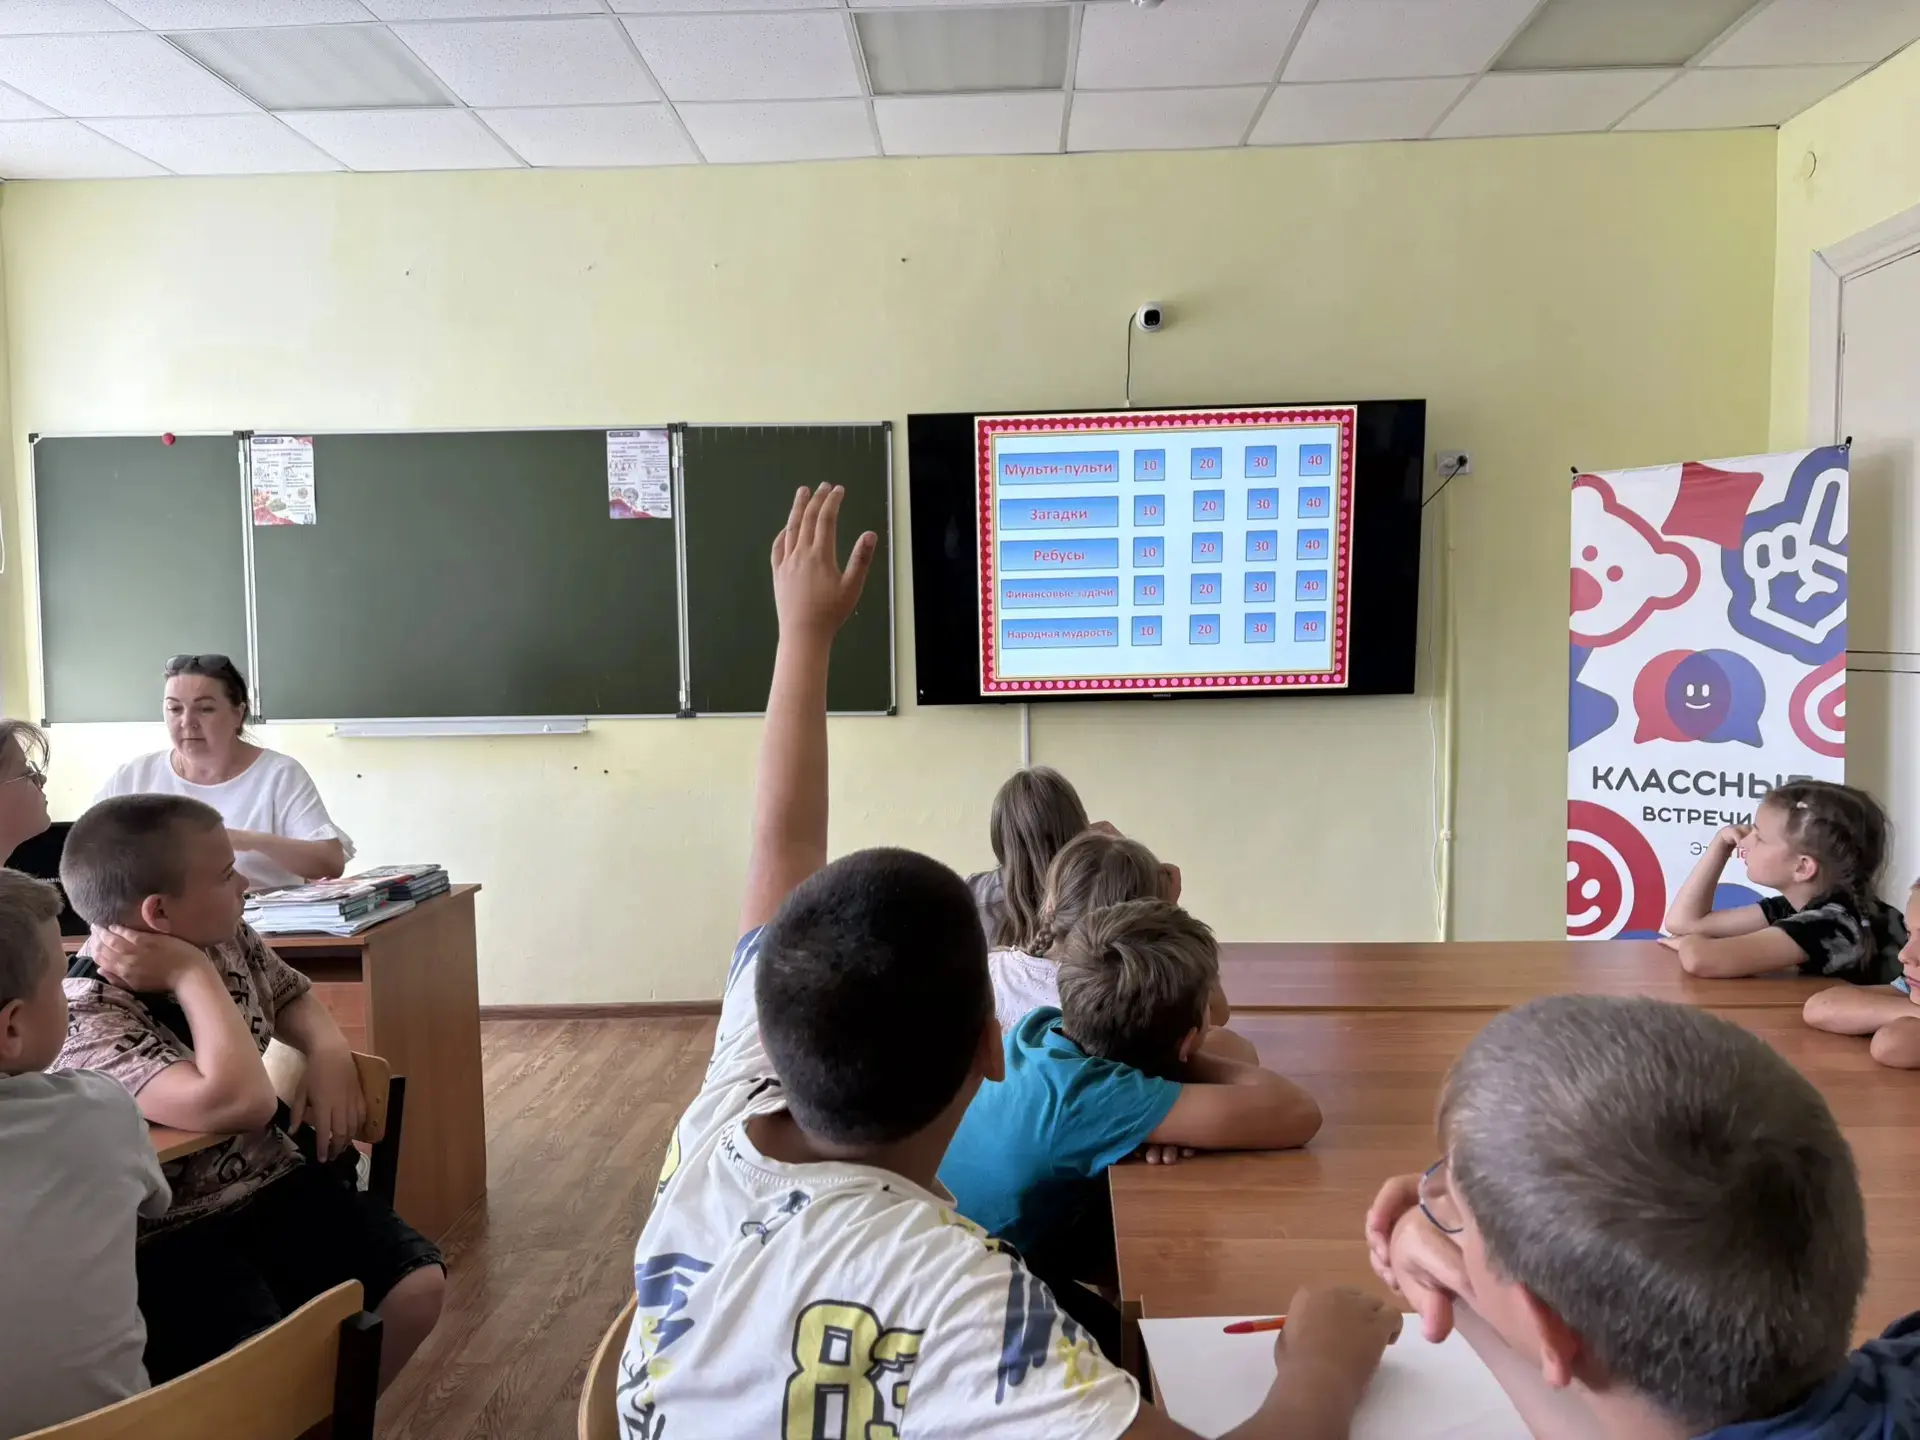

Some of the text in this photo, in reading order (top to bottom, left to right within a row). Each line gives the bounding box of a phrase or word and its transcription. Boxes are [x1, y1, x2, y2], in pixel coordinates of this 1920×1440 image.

[1143, 459, 1158, 471] 10
[1199, 458, 1215, 470] 20
[1254, 456, 1269, 468] 30
[1307, 454, 1323, 467] 40
[1005, 463, 1112, 477] Мульти-пульти
[1202, 500, 1217, 512] 20
[1256, 498, 1270, 510] 30
[1306, 497, 1322, 509] 40
[1030, 508, 1088, 522] Загадки
[1143, 505, 1157, 517] 10
[1200, 542, 1215, 554] 20
[1255, 540, 1269, 552] 30
[1305, 539, 1320, 551] 40
[1033, 549, 1085, 563] Ребусы
[1142, 546, 1157, 558] 10
[1143, 585, 1157, 596] 10
[1199, 583, 1214, 595] 20
[1253, 581, 1268, 593] 30
[1304, 580, 1319, 592] 40
[1140, 626, 1154, 637] 10
[1198, 624, 1212, 636] 20
[1253, 622, 1268, 634] 30
[1303, 621, 1318, 633] 40
[1007, 627, 1112, 640] Народная мудрость
[1643, 806, 1752, 827] ВСТРЕЧИ
